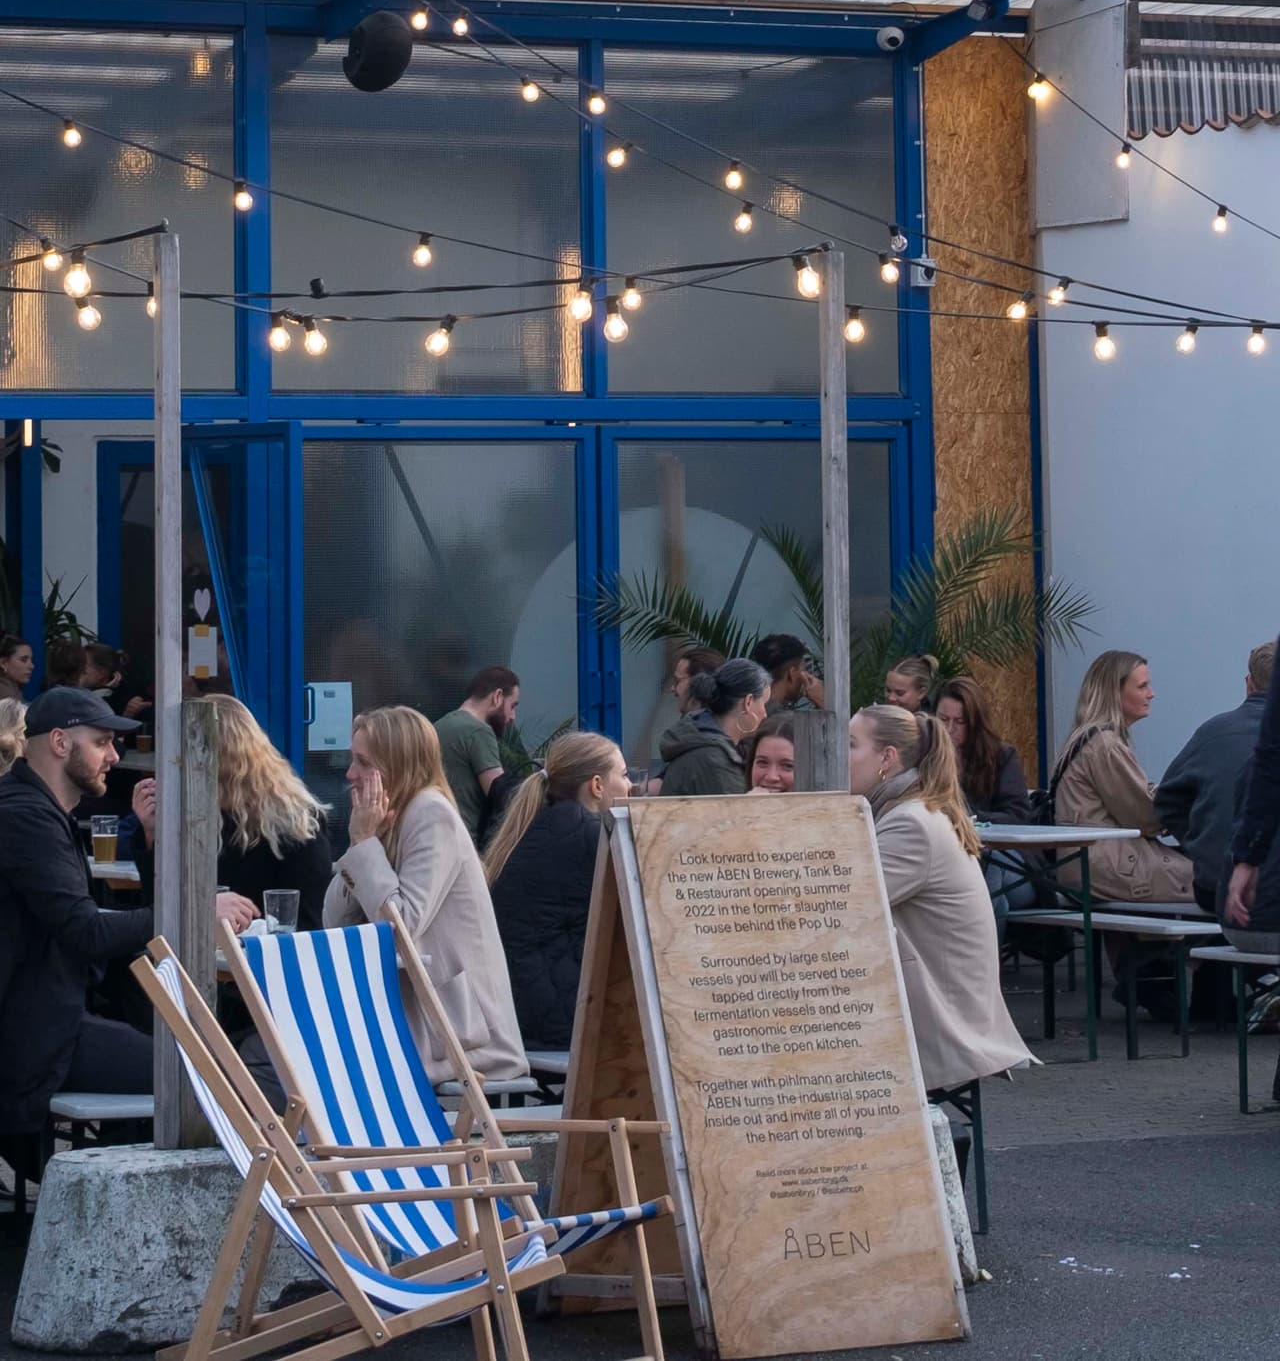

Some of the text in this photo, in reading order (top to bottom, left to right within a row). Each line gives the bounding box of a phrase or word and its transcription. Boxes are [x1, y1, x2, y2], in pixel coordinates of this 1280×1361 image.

[679, 849, 836, 865] Look forward to experience
[668, 864, 852, 883] the new ÅBEN Brewery, Tank Bar
[675, 882, 851, 900] & Restaurant opening summer
[685, 900, 848, 917] 2022 in the former slaughter
[695, 916, 843, 934] house behind the Pop Up.
[701, 950, 849, 969] Surrounded by large steel
[689, 967, 867, 987] vessels you will be served beer
[712, 985, 850, 1005] tapped directly from the
[694, 1001, 874, 1022] fermentation vessels and enjoy
[713, 1021, 861, 1040] gastronomic experiences
[719, 1037, 862, 1056] next to the open kitchen.
[696, 1070, 897, 1094] Together with pihlmann architects,
[707, 1088, 891, 1109] ÅBEN turns the industrial space
[743, 1112, 762, 1126] out
[766, 1111, 788, 1123] and
[790, 1109, 821, 1122] invite
[824, 1108, 837, 1119] all
[840, 1107, 852, 1118] of
[855, 1107, 875, 1120] you
[877, 1104, 900, 1116] into
[746, 1125, 866, 1143] the heart of brewing.
[784, 1228, 871, 1260] ÅBEN
